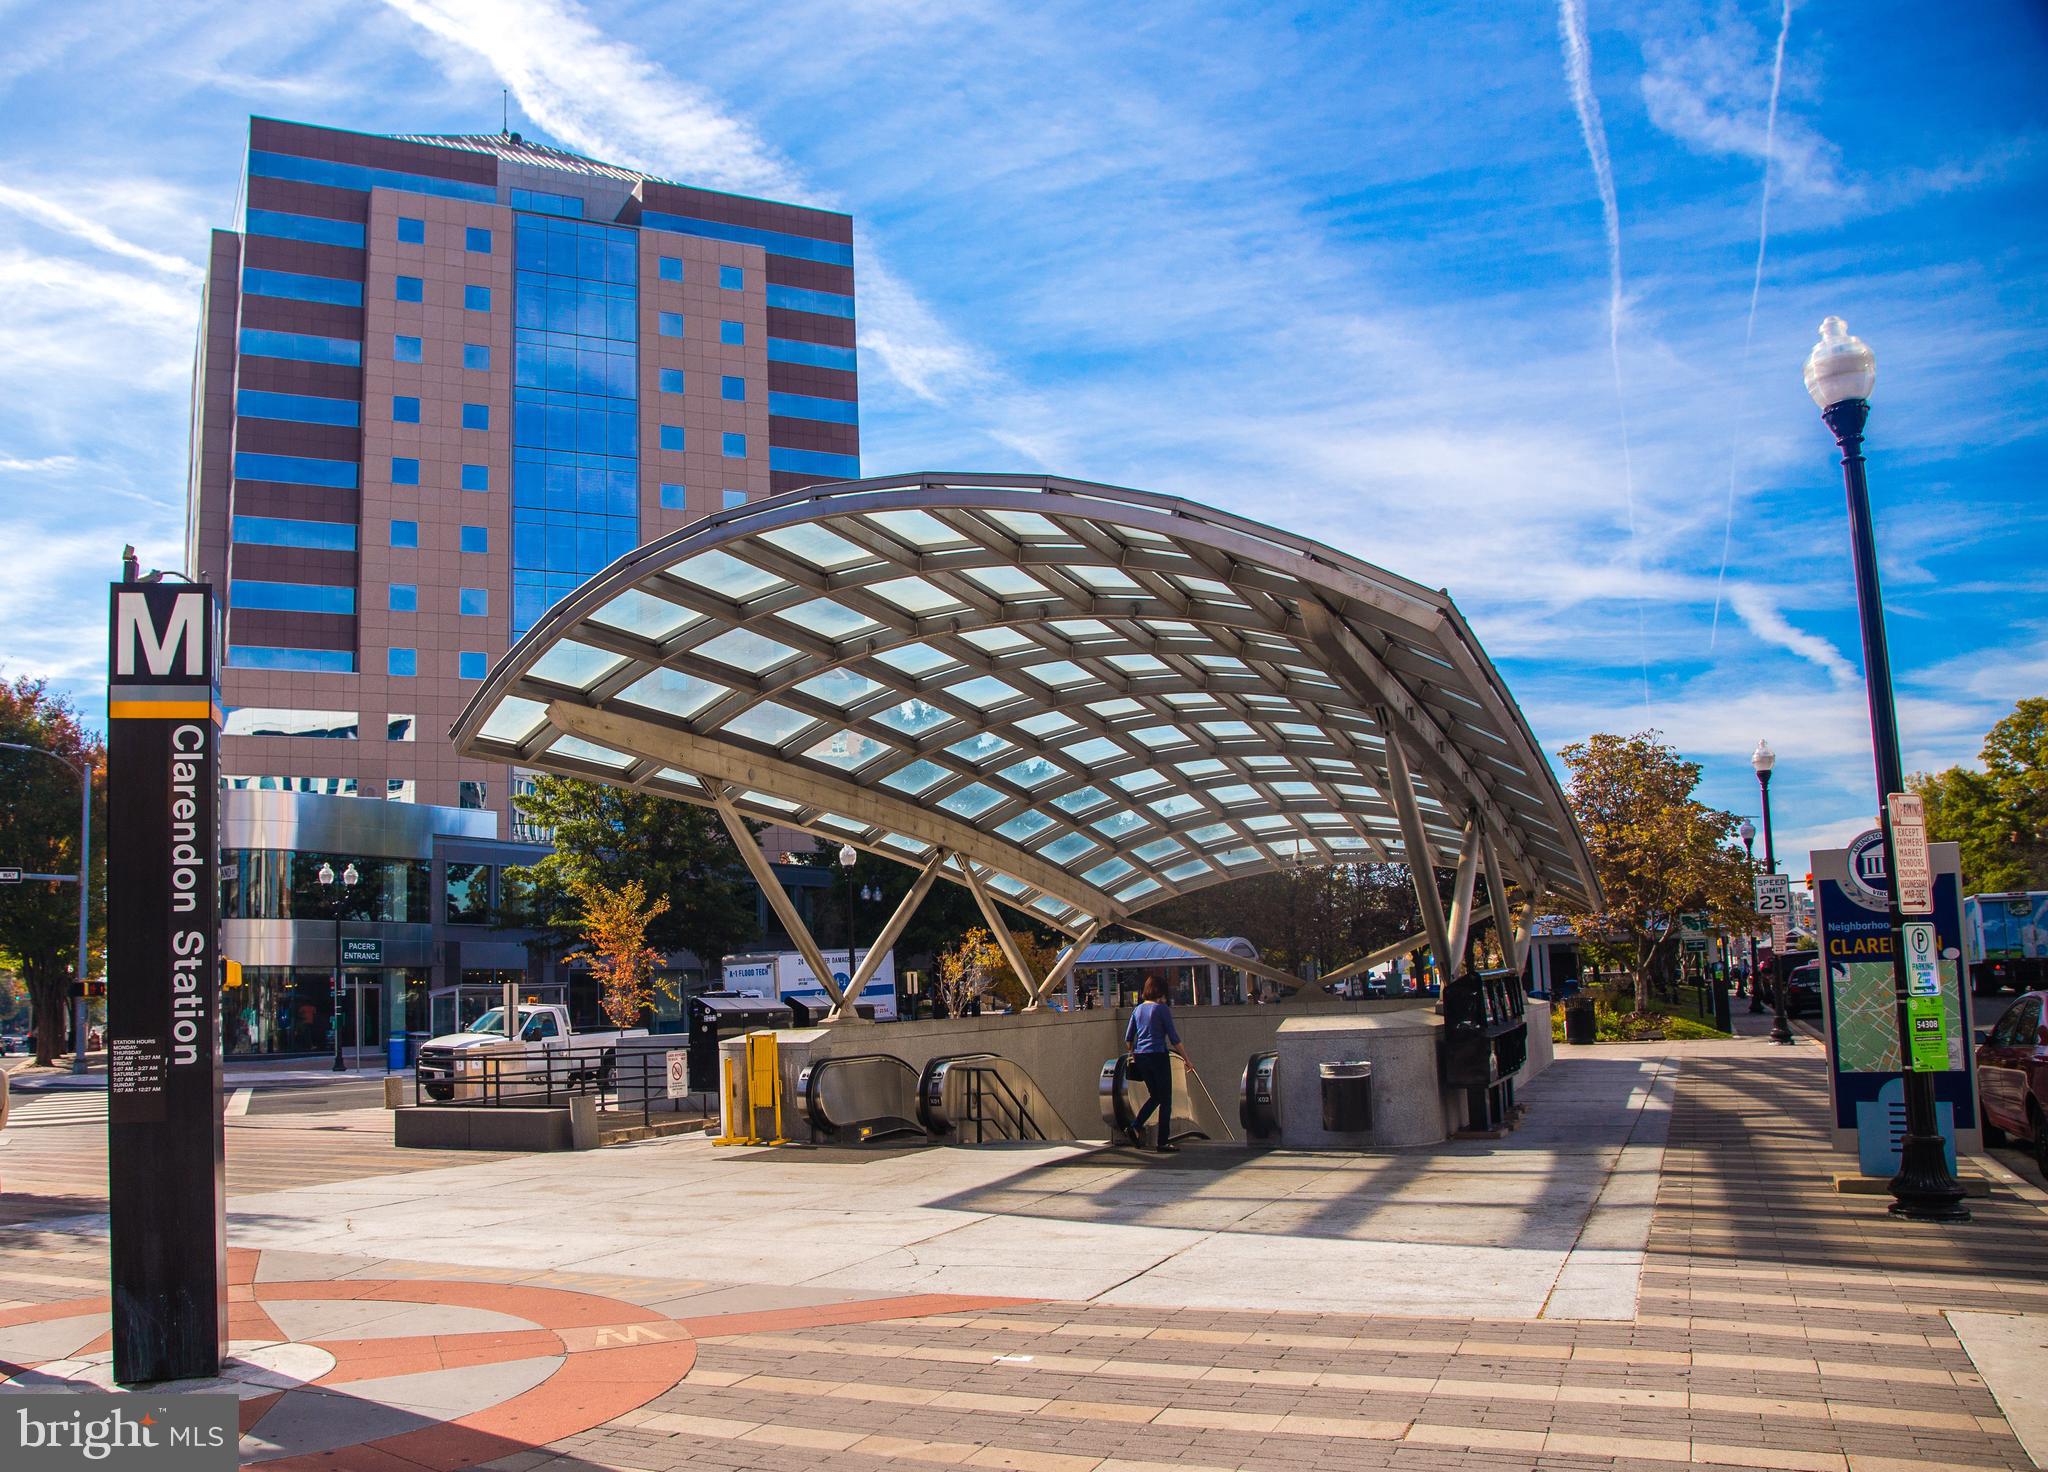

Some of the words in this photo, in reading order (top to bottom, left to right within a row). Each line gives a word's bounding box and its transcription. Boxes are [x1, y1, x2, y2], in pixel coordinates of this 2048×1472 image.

[117, 592, 204, 676] M
[172, 724, 205, 912] Clarendon
[1897, 828, 1919, 837] EXCEPT
[1853, 832, 1882, 855] ARLINGTO
[1896, 838, 1923, 847] FARMERS
[1899, 848, 1922, 857] MARKET
[1899, 859, 1925, 868] VENDORS
[1757, 879, 1787, 887] SPEED
[1900, 880, 1928, 889] WEDNESDAY
[1761, 886, 1783, 894] LIMIT
[1904, 890, 1926, 899] MAR-DEC
[1759, 895, 1787, 910] 25
[1828, 921, 1890, 933] Neighborhoo
[1916, 932, 1925, 950] P
[348, 942, 376, 950] PACERS
[344, 952, 380, 960] ENTRANCE
[1916, 953, 1928, 963] PAY
[1911, 962, 1936, 972] PARKING
[739, 969, 755, 977] FLOOD
[755, 968, 769, 976] TECH
[172, 930, 205, 1065] Station
[1916, 1019, 1939, 1029] 54308
